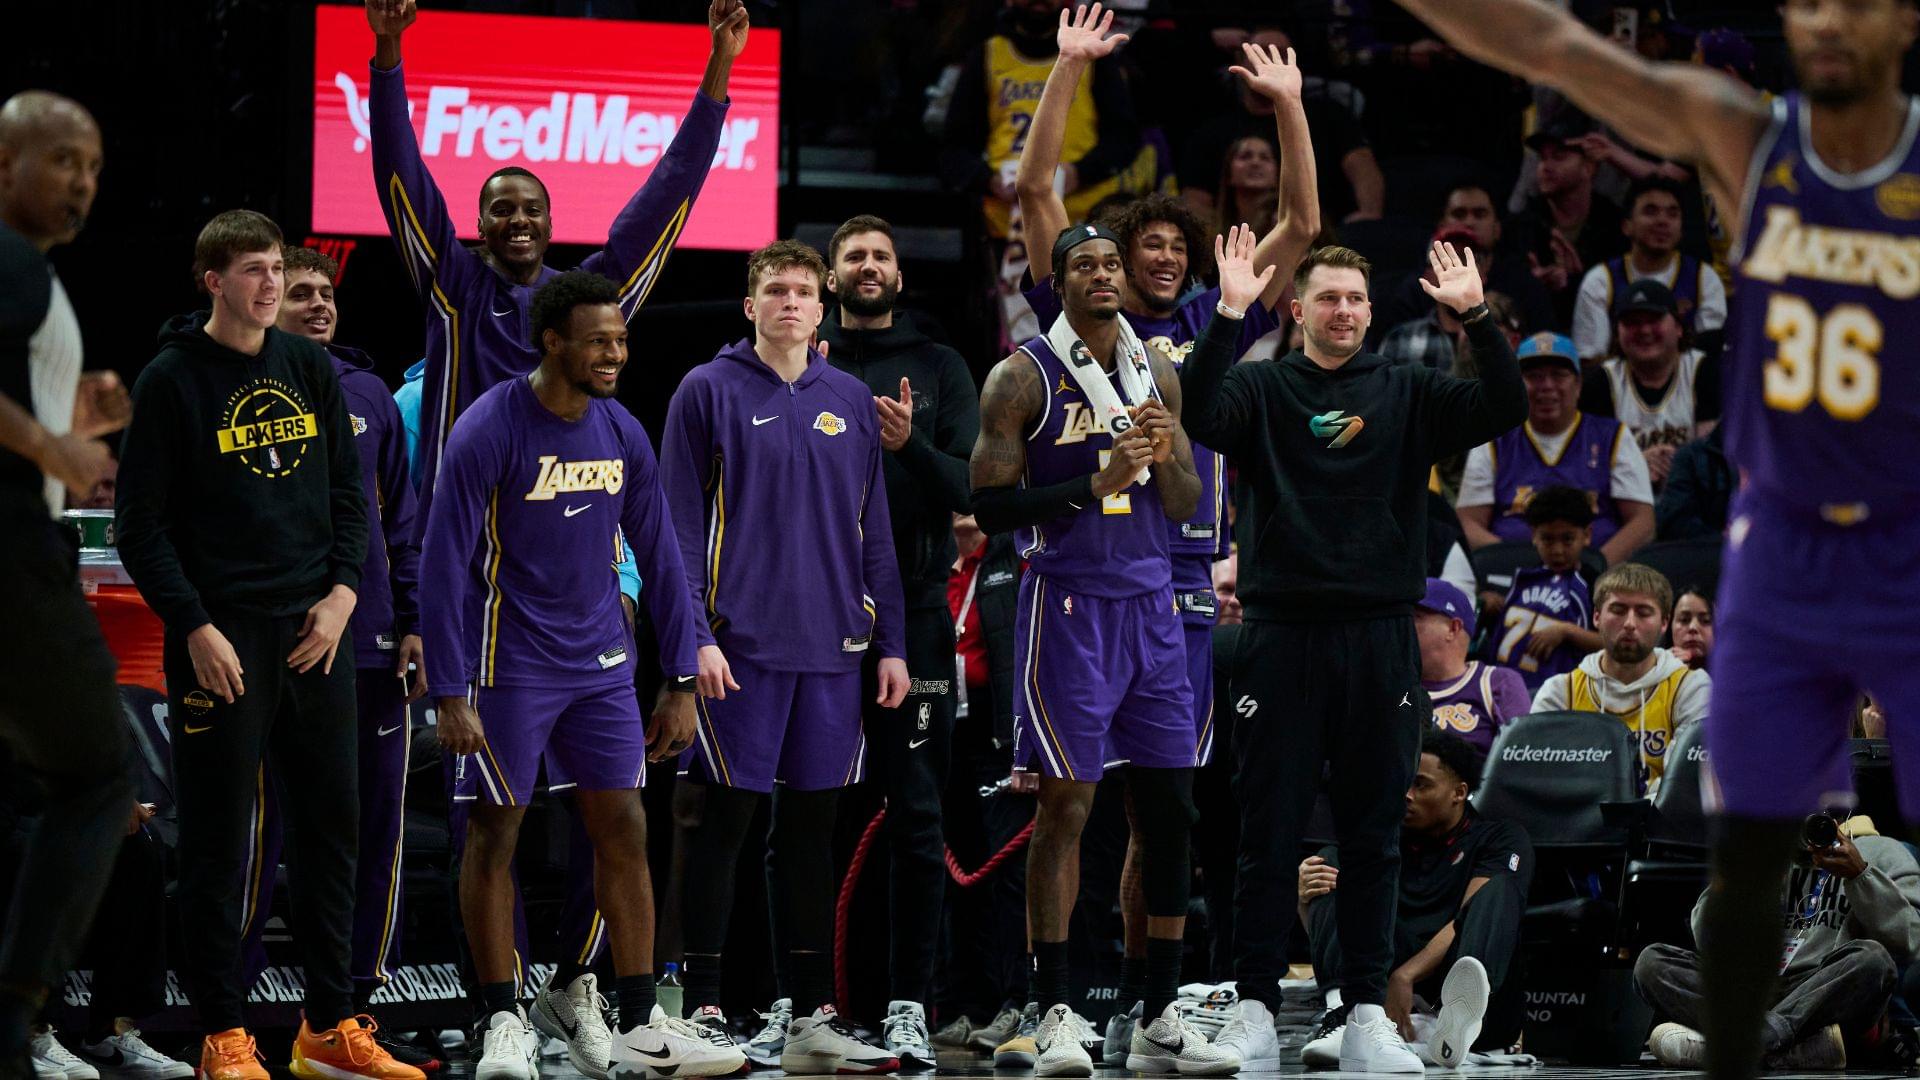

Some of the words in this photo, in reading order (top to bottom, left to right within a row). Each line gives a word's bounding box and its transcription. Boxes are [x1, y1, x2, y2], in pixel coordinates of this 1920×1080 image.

[1761, 289, 1885, 422] 36
[231, 417, 307, 448] LAKERS
[523, 455, 624, 501] LAKERS
[1502, 745, 1612, 762] ticketmaster
